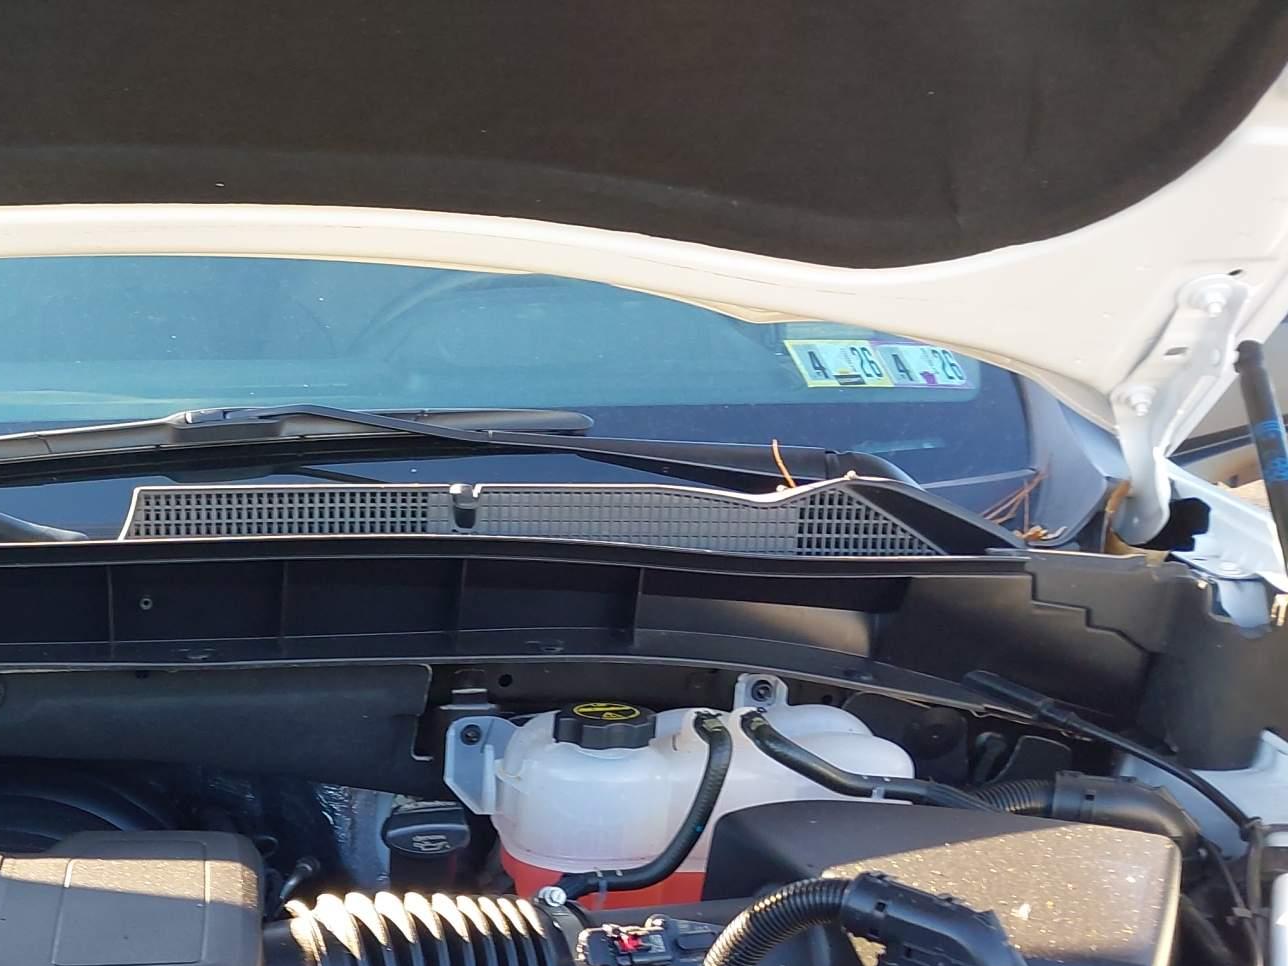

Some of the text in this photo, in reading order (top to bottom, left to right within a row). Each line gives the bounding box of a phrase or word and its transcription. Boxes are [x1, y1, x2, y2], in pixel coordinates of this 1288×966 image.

[807, 350, 830, 379] 4
[849, 346, 885, 378] 26
[891, 353, 915, 382] 4
[930, 348, 965, 381] 26
